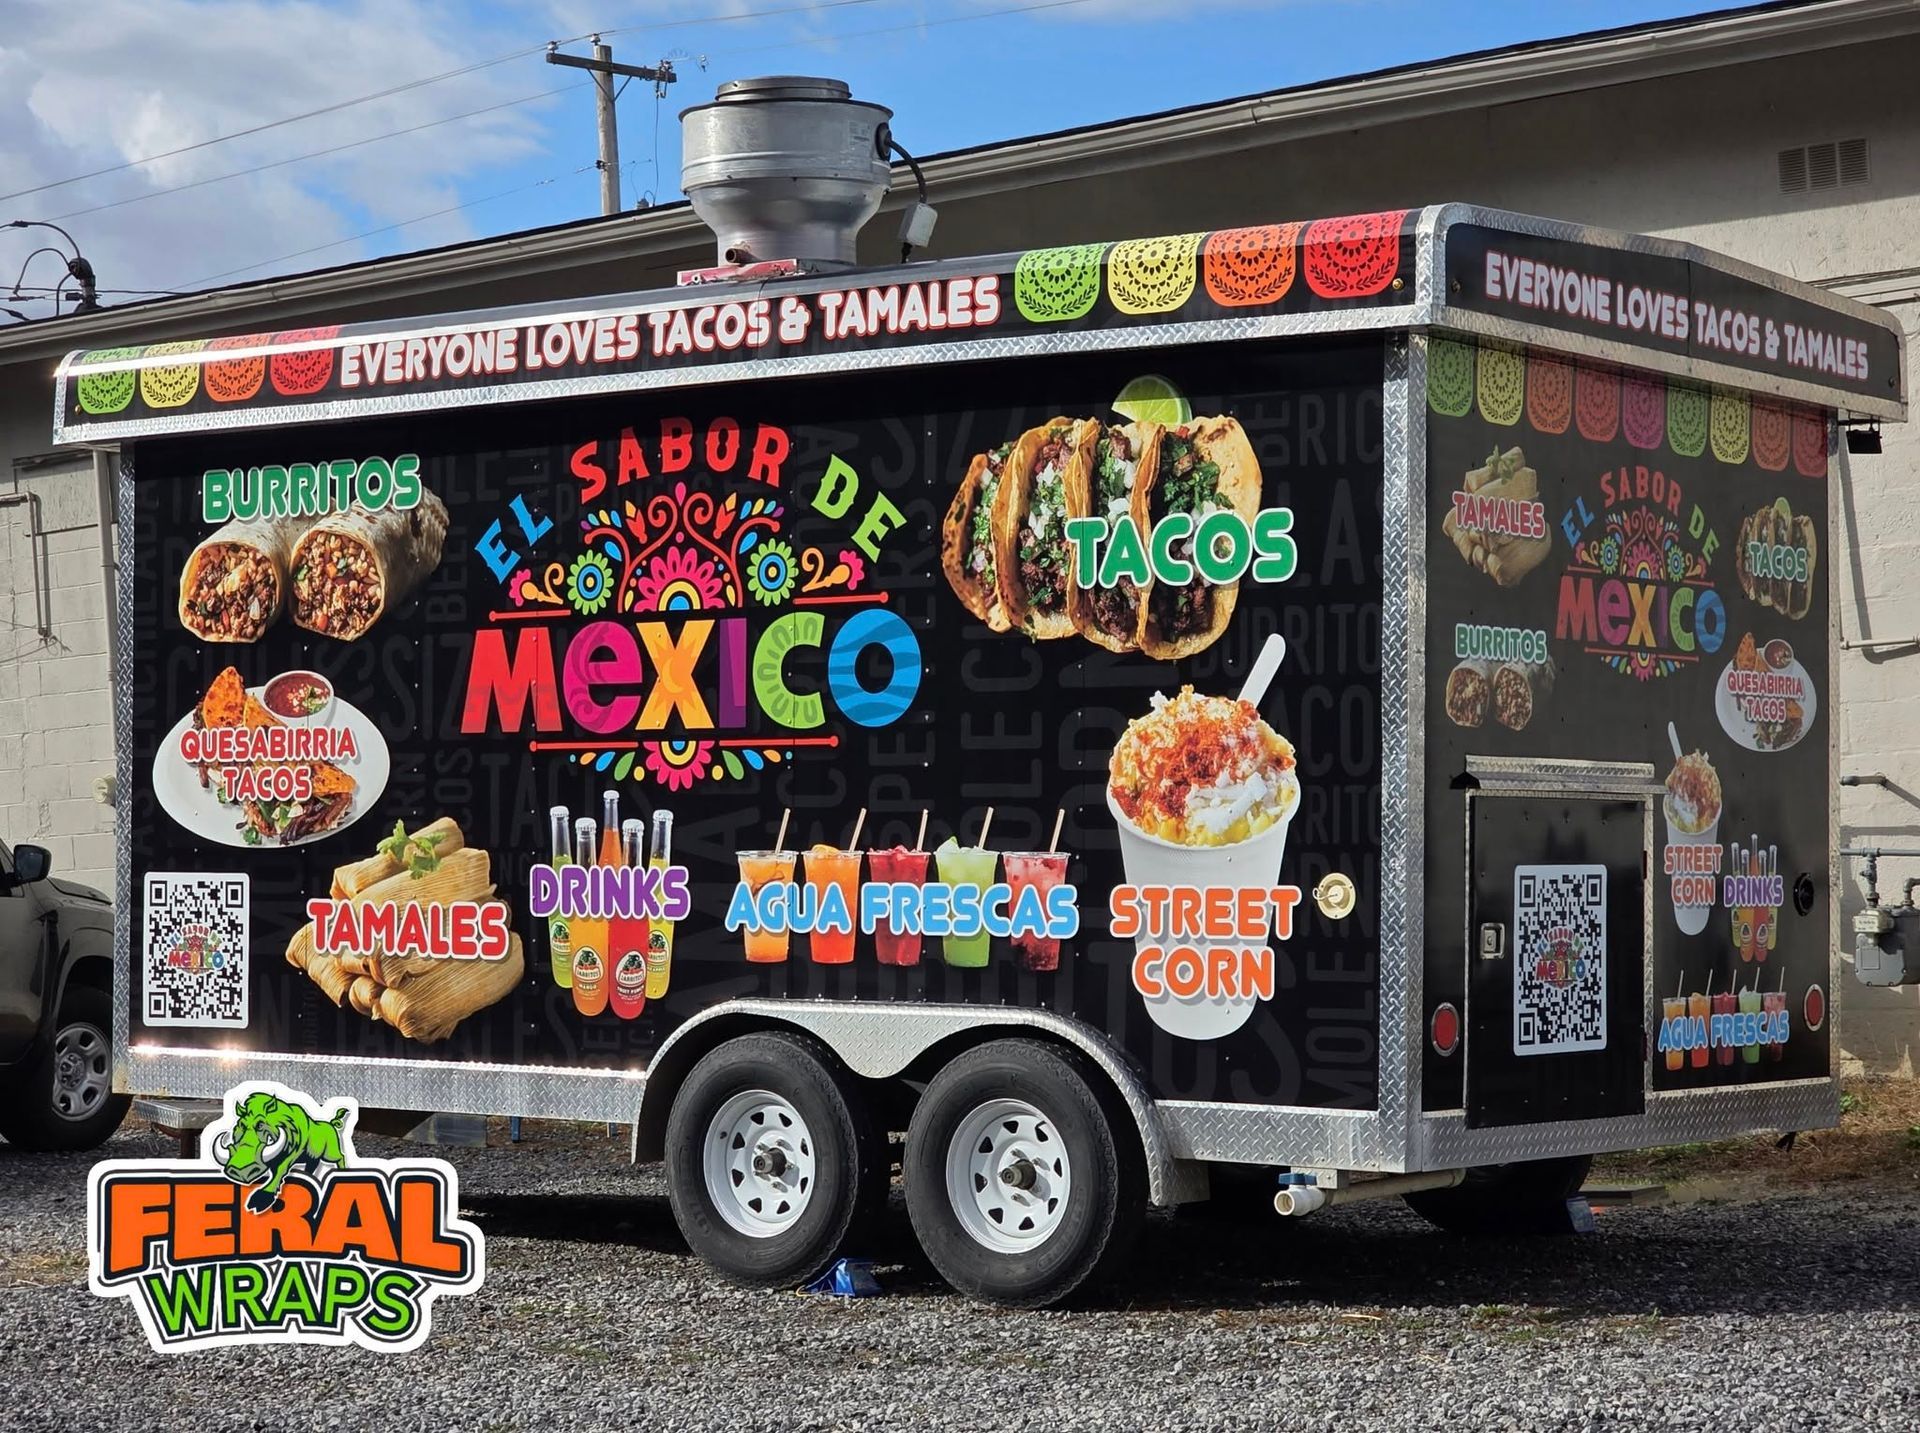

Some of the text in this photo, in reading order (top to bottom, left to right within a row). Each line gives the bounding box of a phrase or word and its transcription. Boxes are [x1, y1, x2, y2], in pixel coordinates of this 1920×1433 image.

[339, 274, 1000, 389] EVERYONE LOVES TACOS & TAMALES
[1485, 249, 1869, 380] EVERYONE LOVES TACOS & TAMALES
[202, 453, 422, 524] BURRITOS
[474, 494, 554, 585] EL
[570, 416, 790, 505] SABOR
[810, 454, 907, 564] DE
[1452, 490, 1546, 539] TAMALES
[1561, 465, 1721, 565] EL SABOR DE
[1065, 507, 1297, 590] TACOS
[1749, 540, 1808, 583] TACOS
[1455, 622, 1547, 664] BURRITOS
[1726, 669, 1804, 698] QUESABIRRIA
[1745, 695, 1786, 723] TACOS
[180, 727, 357, 763] QUESABIRRIA
[223, 766, 311, 801] TACOS
[1664, 843, 1723, 876] STREET
[530, 864, 691, 921] DRINKS
[724, 881, 1078, 939] AGUA FRESCAS
[1109, 885, 1302, 940] STREET
[1671, 876, 1716, 907] CORN
[1724, 875, 1784, 907] DRINKS
[306, 898, 510, 961] TAMALES
[1131, 945, 1276, 1001] CORN
[1658, 1010, 1790, 1052] AGUA FRESCAS
